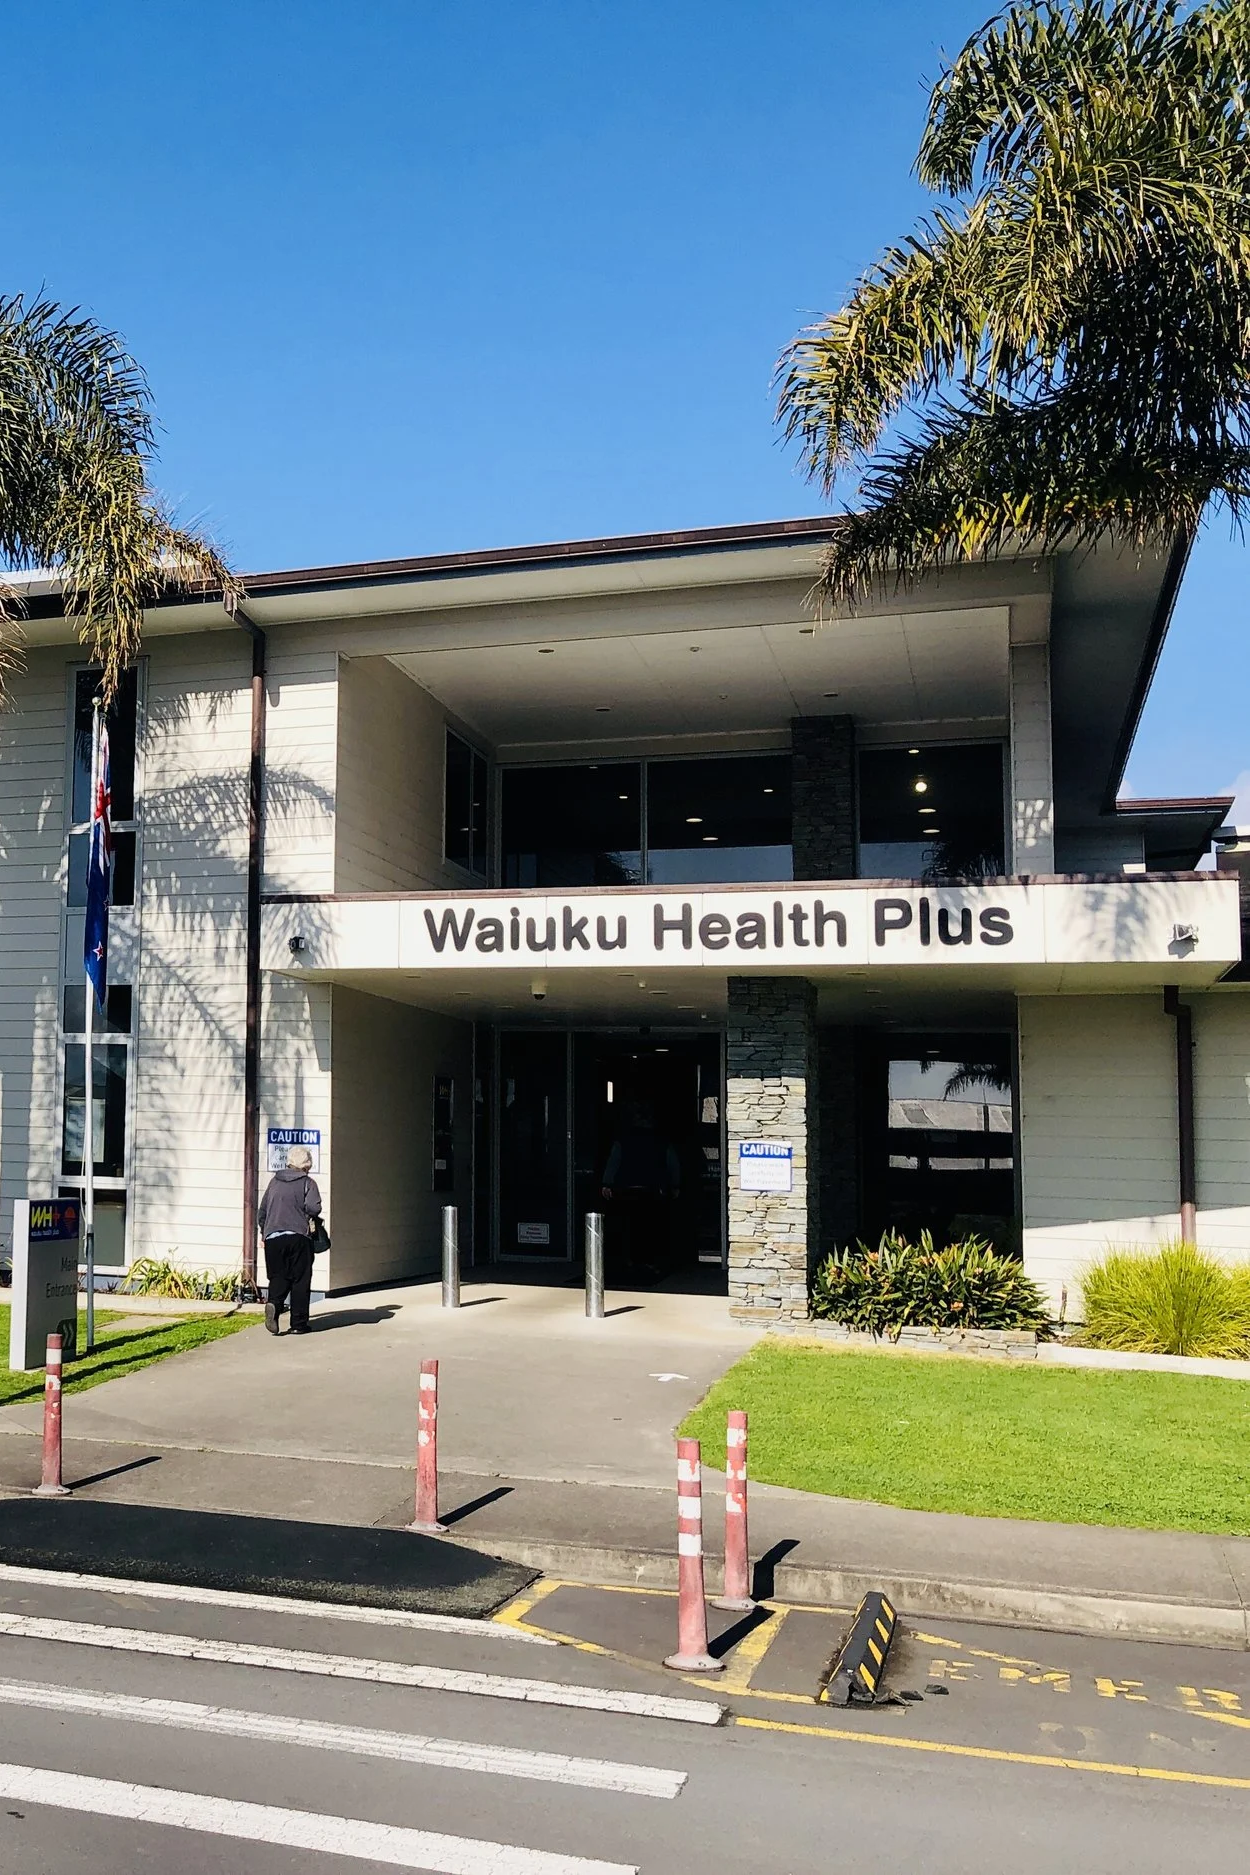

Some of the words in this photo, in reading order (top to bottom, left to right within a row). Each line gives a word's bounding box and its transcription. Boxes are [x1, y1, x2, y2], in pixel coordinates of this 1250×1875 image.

[423, 905, 627, 953] Waiuku
[653, 899, 847, 951] Health
[874, 896, 1015, 947] Plus
[270, 1130, 318, 1144] CAUTION
[742, 1143, 789, 1156] CAUTION
[61, 1256, 78, 1272] Main
[46, 1282, 78, 1299] Entrance
